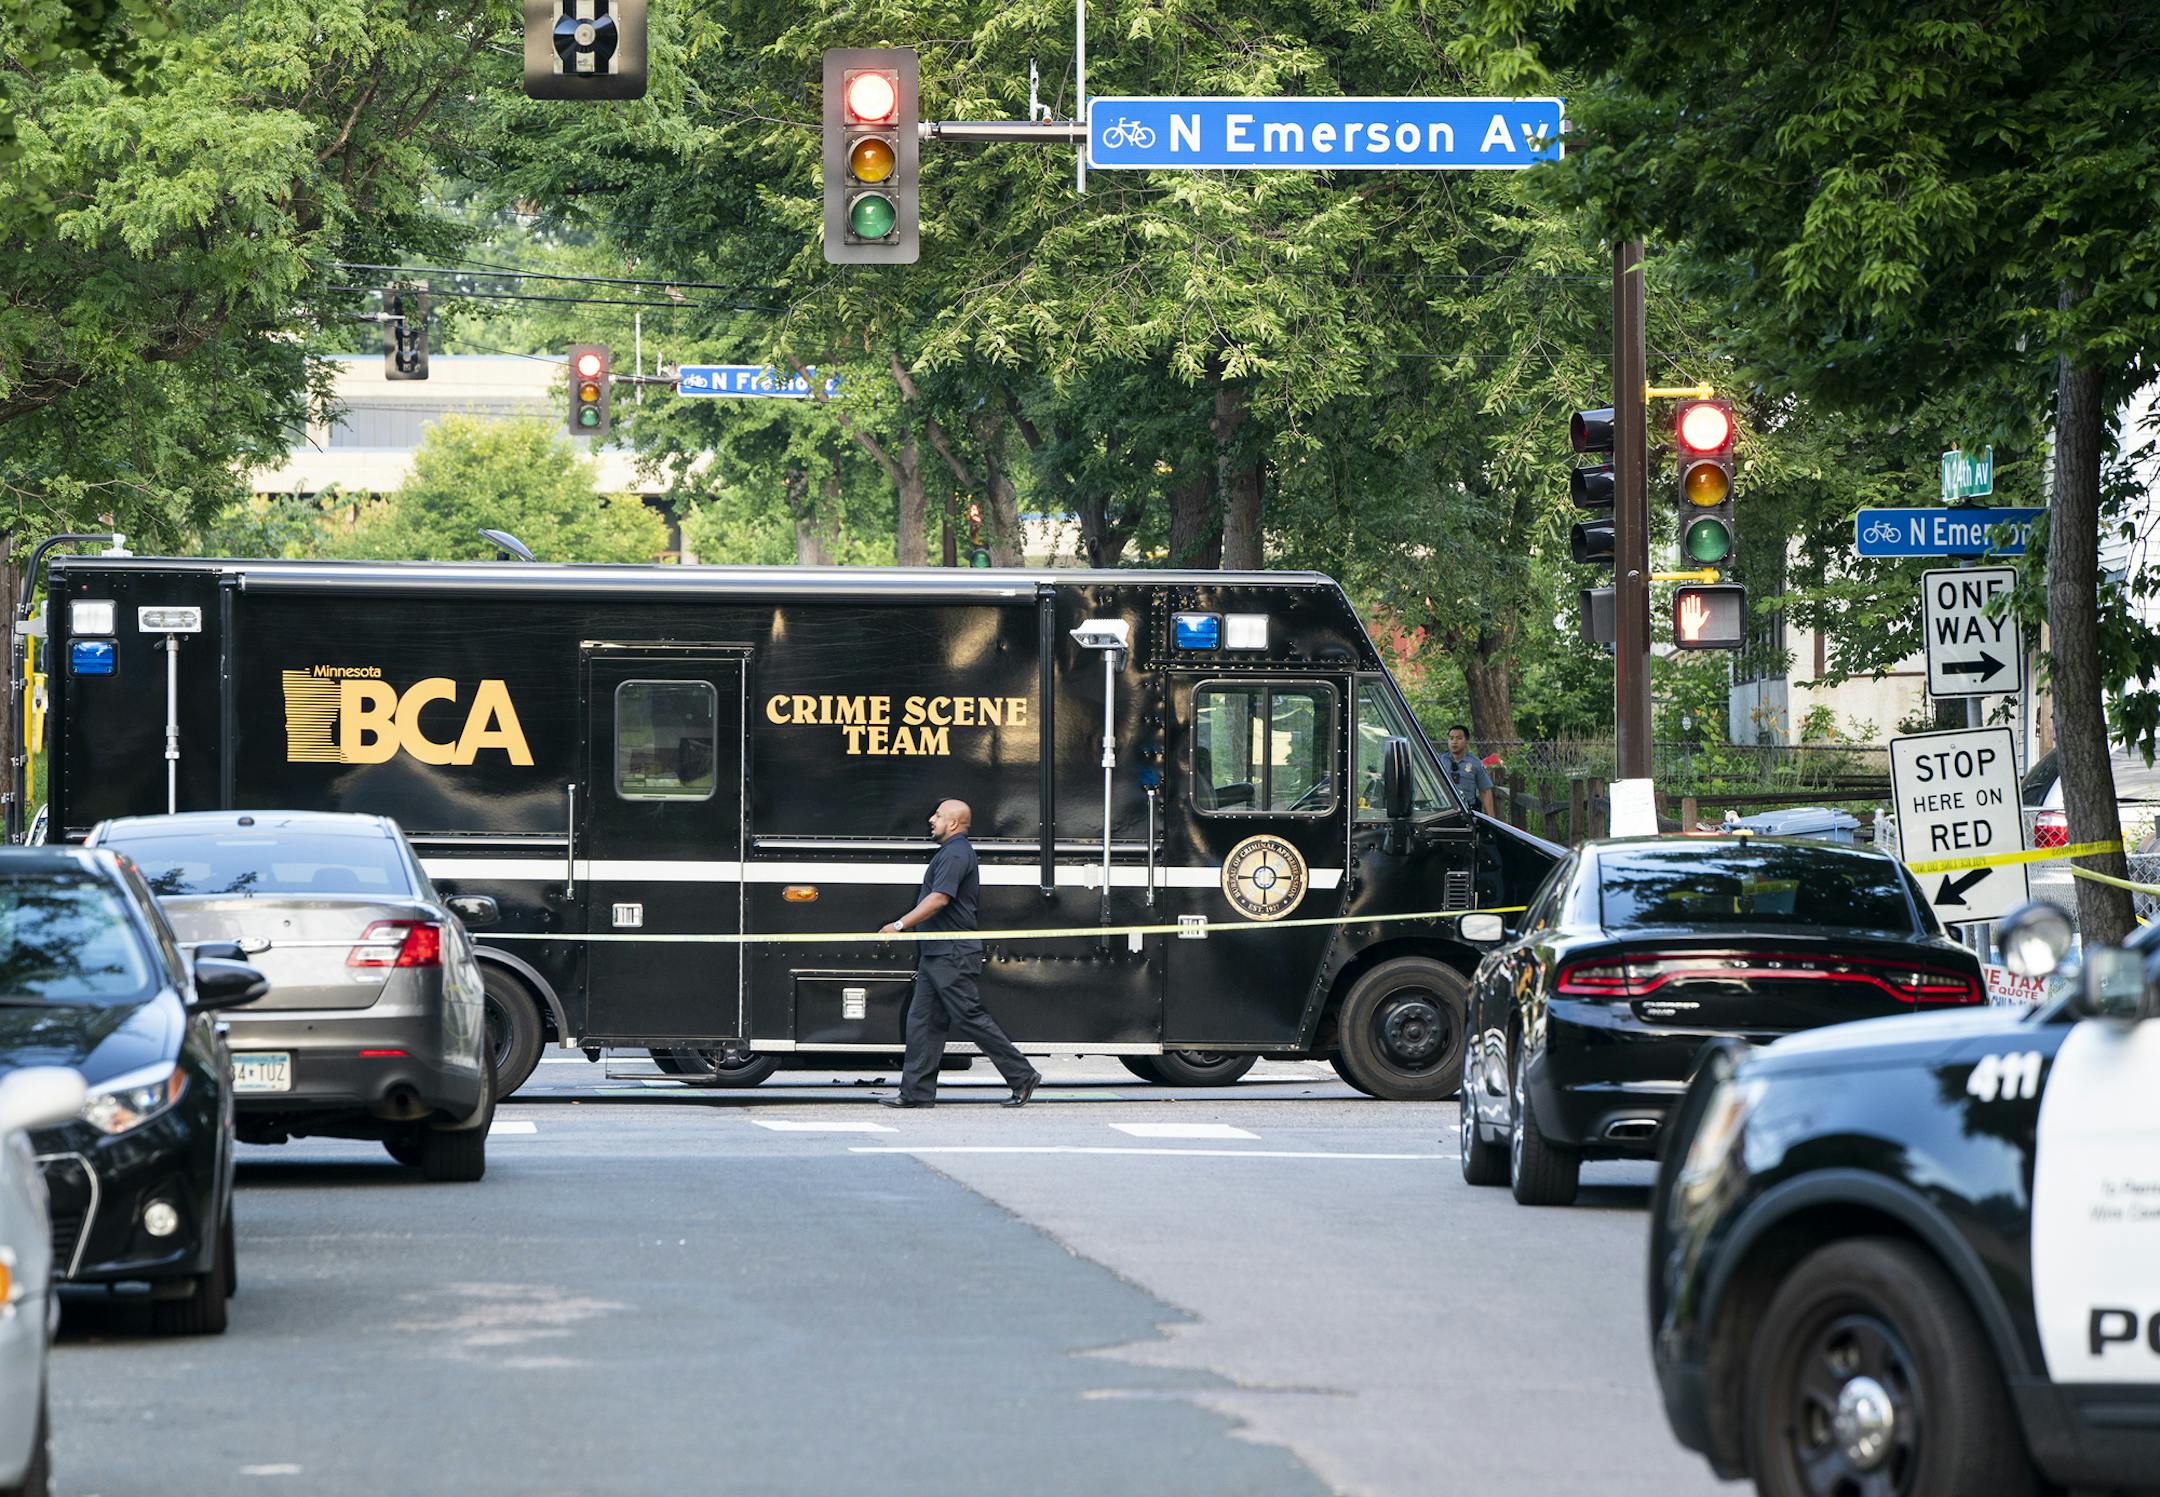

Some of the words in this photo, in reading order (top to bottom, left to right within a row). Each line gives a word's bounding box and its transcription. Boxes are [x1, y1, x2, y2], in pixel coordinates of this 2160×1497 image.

[1170, 114, 1200, 152] N
[1226, 114, 1455, 153] Emerson
[1481, 114, 1549, 153] Av
[712, 372, 728, 390] N
[1952, 460, 1973, 488] 24th
[1910, 518, 1925, 546] N
[1936, 615, 2008, 645] WAY
[313, 665, 382, 678] Minnesota
[340, 677, 535, 766] BCA
[766, 694, 890, 725] CRIME
[902, 696, 1028, 726] SCENE
[842, 725, 951, 755] TEAM
[1915, 749, 1996, 782] STOP
[1913, 792, 1965, 813] HERE
[1976, 788, 2002, 806] ON
[1930, 819, 1992, 852] RED
[1998, 986, 2038, 1000] QUOTE
[2007, 970, 2046, 993] TAX
[258, 1063, 285, 1082] TUZ
[1966, 1050, 2043, 1103] 411
